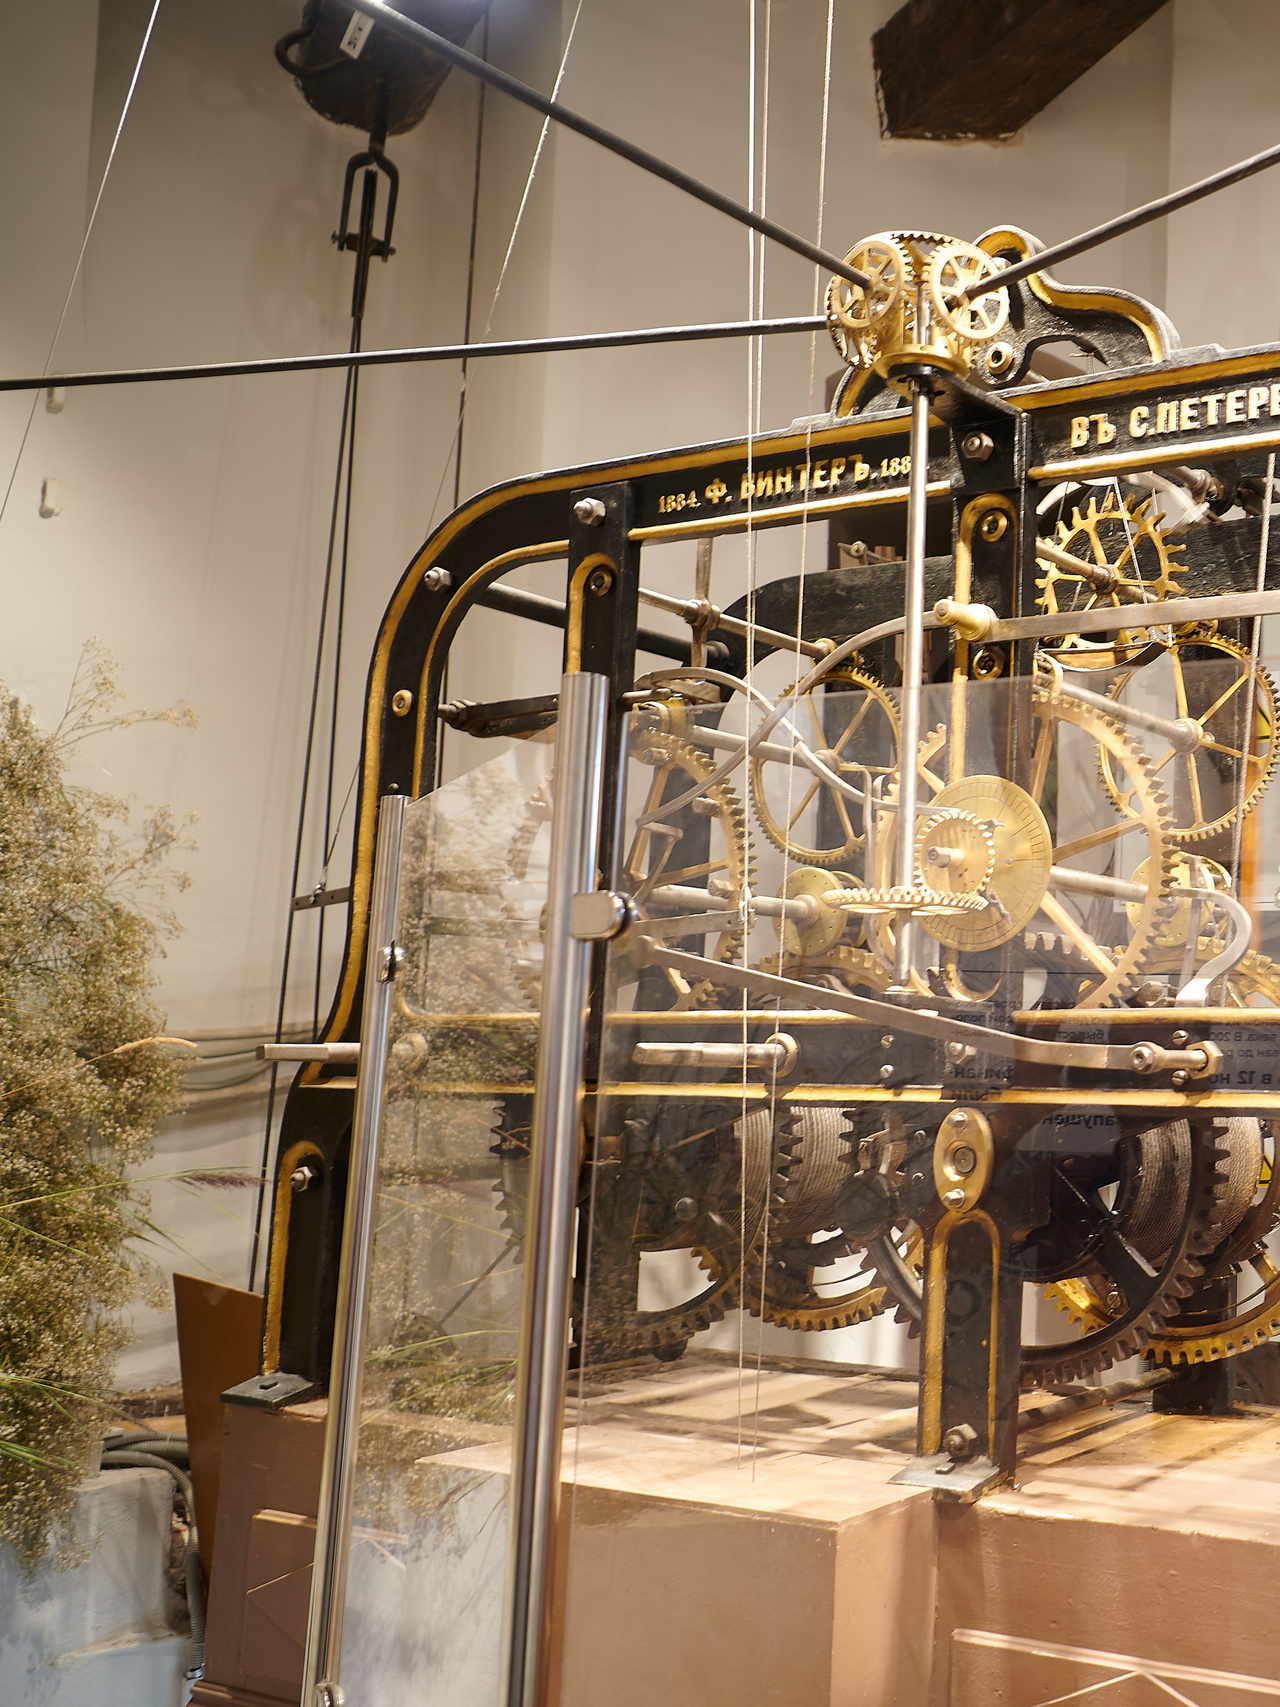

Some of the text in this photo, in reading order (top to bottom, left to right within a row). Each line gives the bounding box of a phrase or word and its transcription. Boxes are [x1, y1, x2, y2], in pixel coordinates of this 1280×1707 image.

[1070, 413, 1117, 450] ВЪ
[704, 477, 732, 505] Ф.
[880, 455, 912, 478] 188
